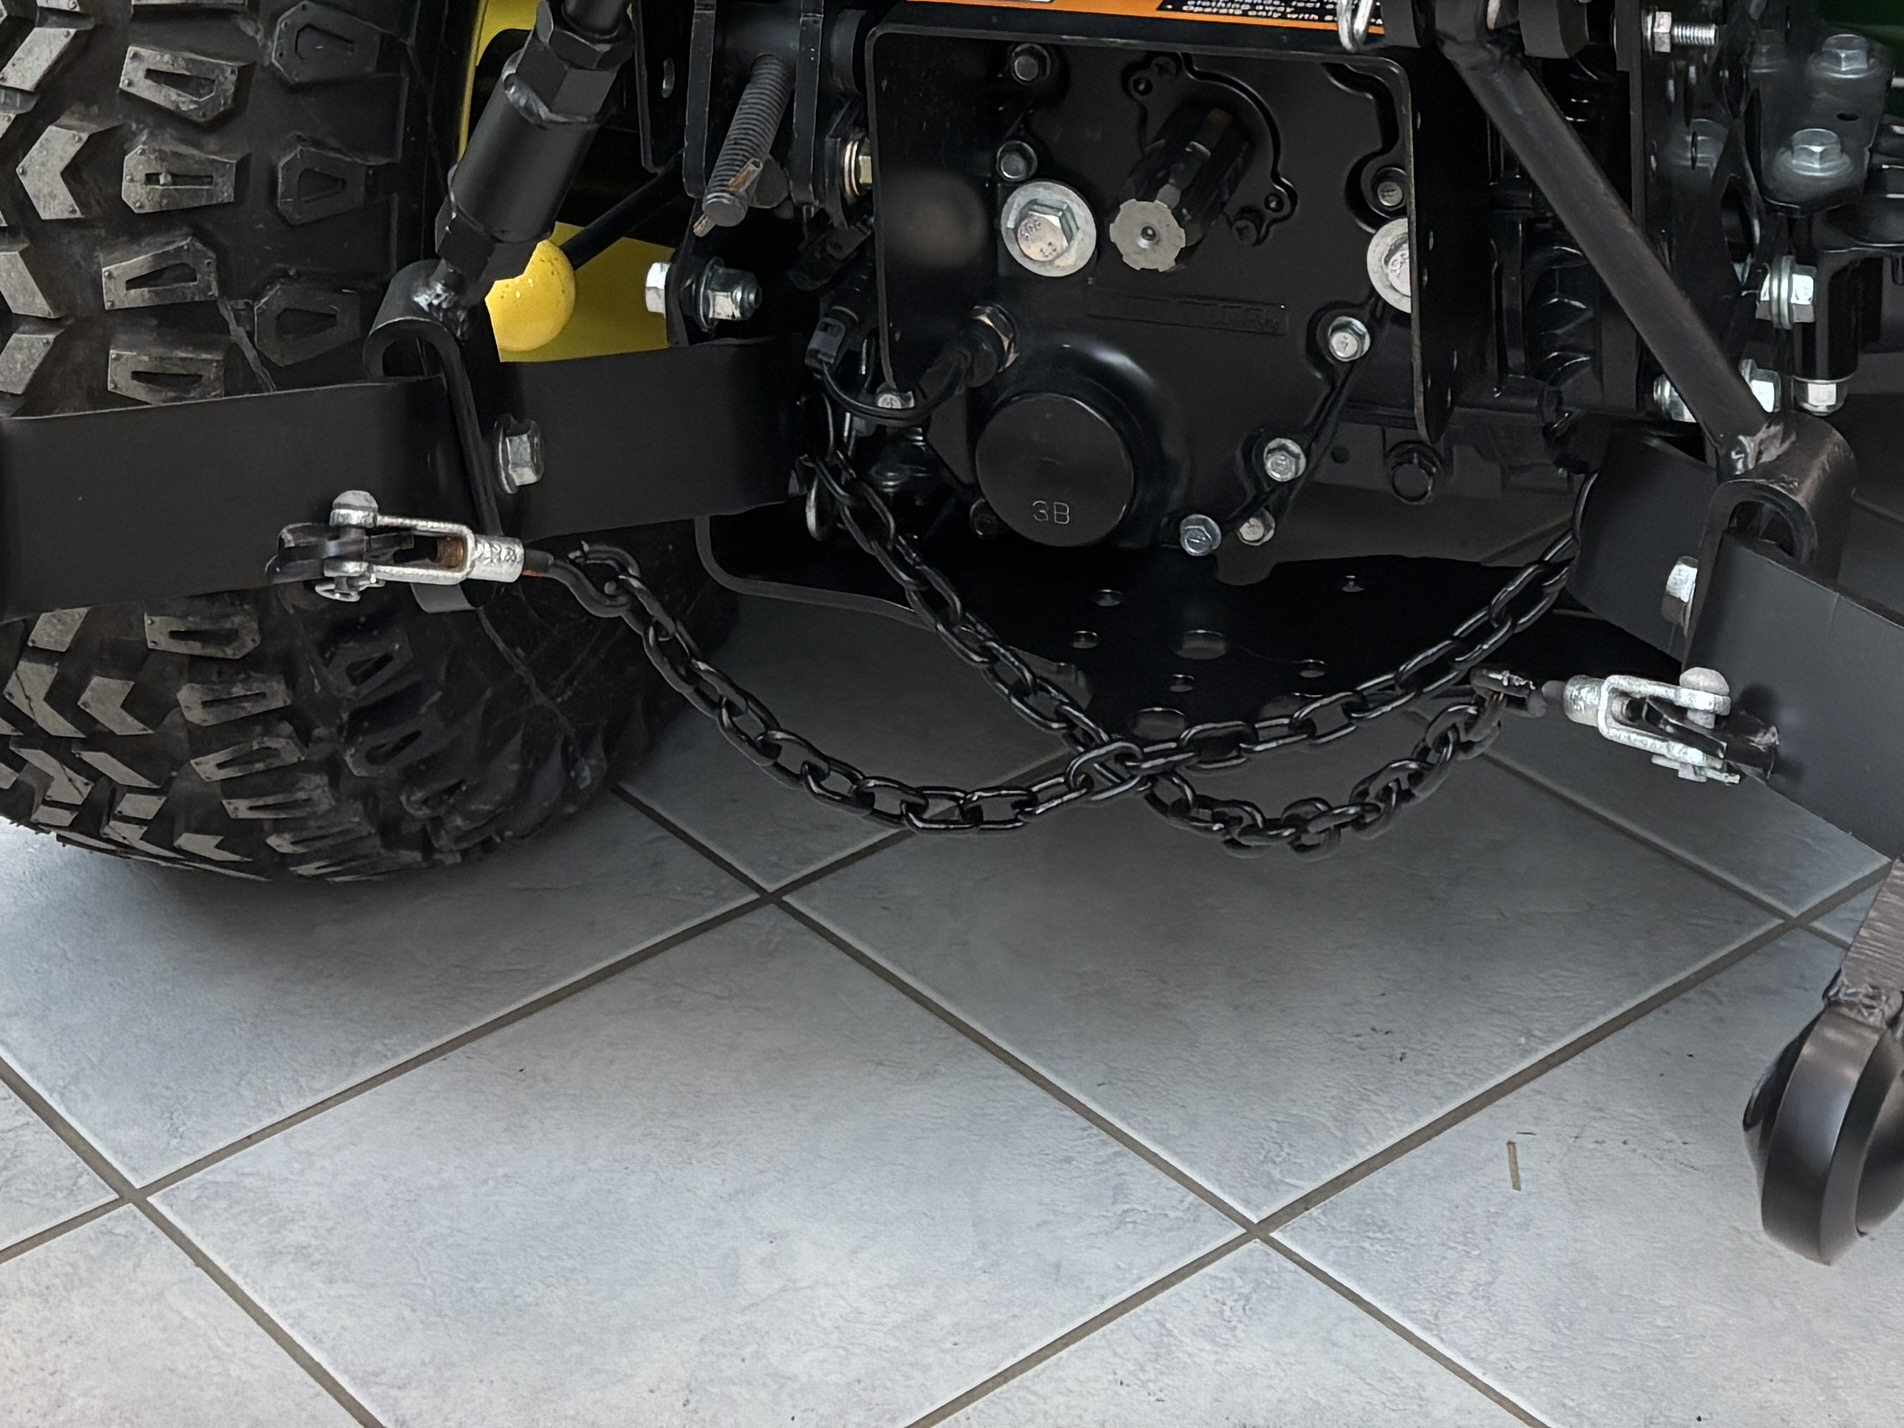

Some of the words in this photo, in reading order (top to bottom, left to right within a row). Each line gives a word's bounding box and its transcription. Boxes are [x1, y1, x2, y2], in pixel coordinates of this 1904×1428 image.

[1182, 5, 1243, 16] Operate
[1247, 10, 1282, 20] only
[1286, 13, 1319, 22] with
[1255, 5, 1296, 14] away
[1032, 498, 1071, 525] 3B
